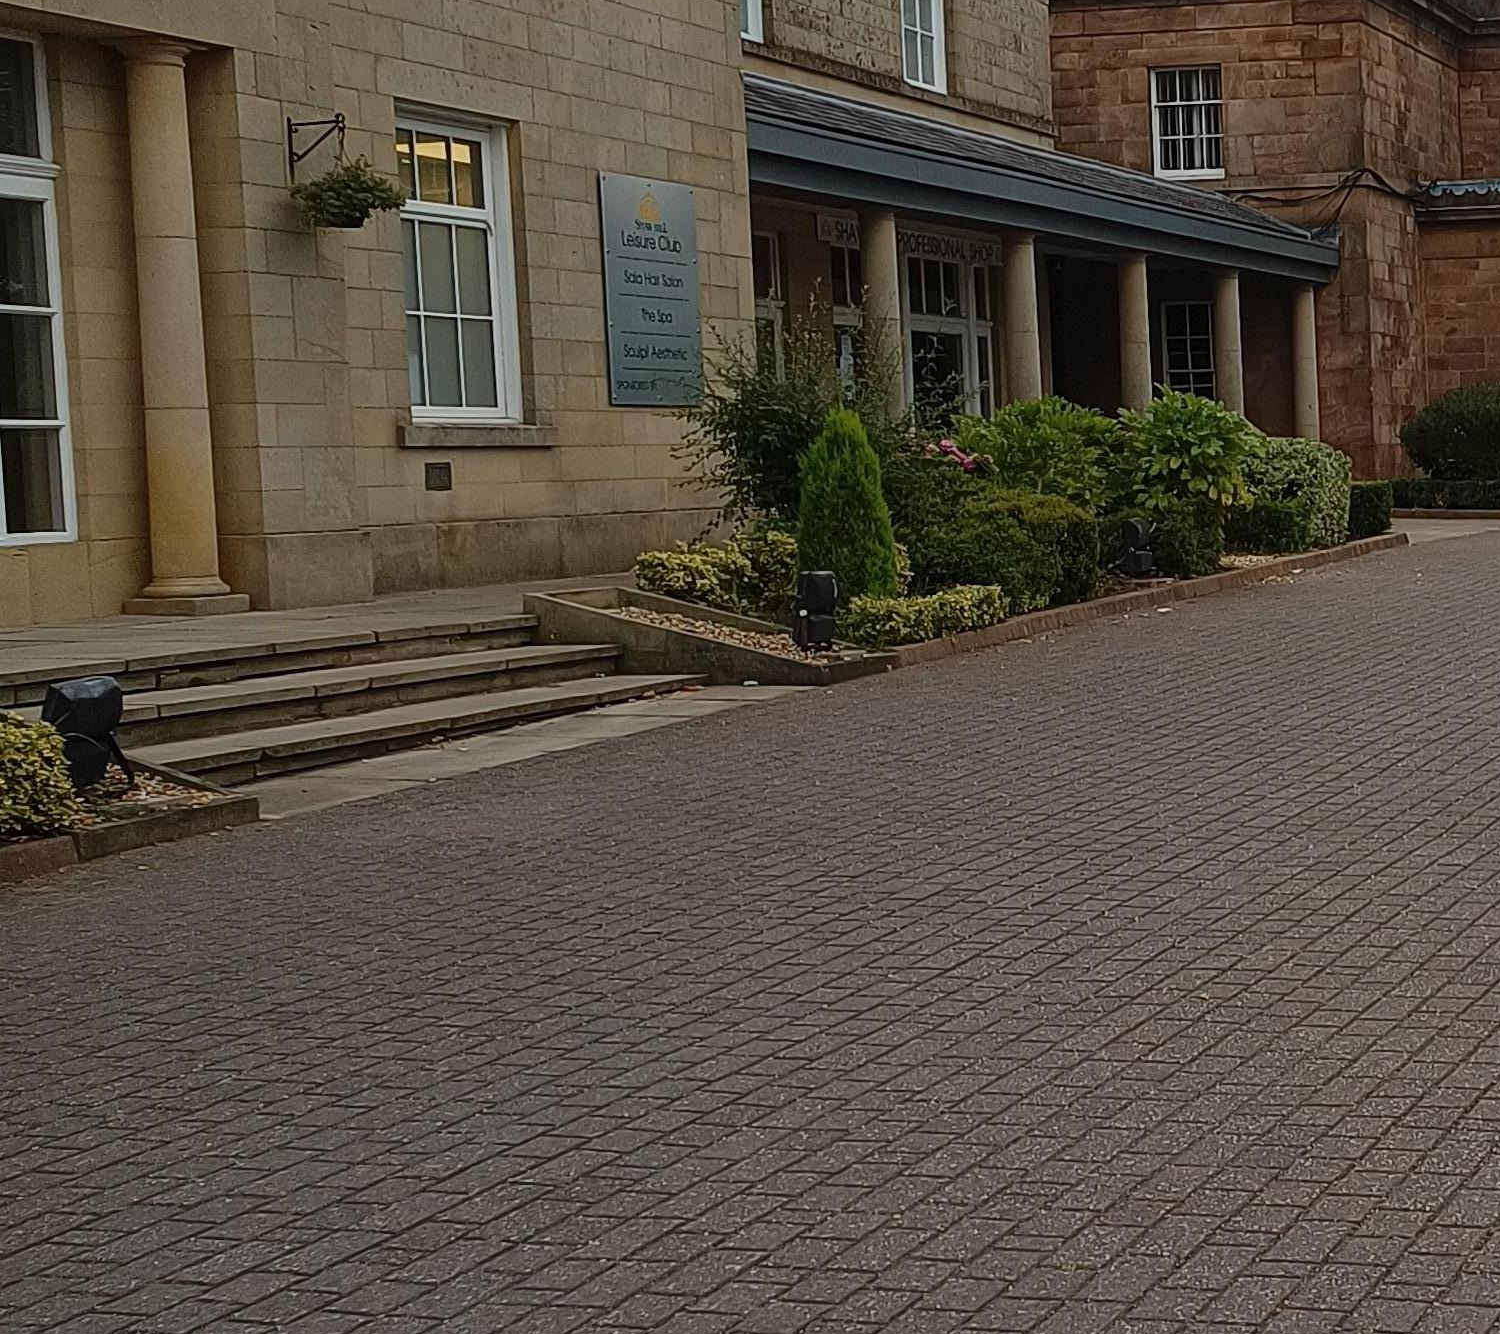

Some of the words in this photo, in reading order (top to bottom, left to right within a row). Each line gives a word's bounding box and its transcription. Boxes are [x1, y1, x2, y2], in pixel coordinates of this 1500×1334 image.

[621, 229, 656, 251] Leisure
[658, 234, 682, 254] Club
[834, 220, 857, 243] SHA
[896, 231, 966, 259] PROFESSIONAL
[969, 242, 994, 262] SHOP
[661, 273, 684, 288] Salon
[641, 307, 656, 323] The
[656, 309, 673, 326] Spa
